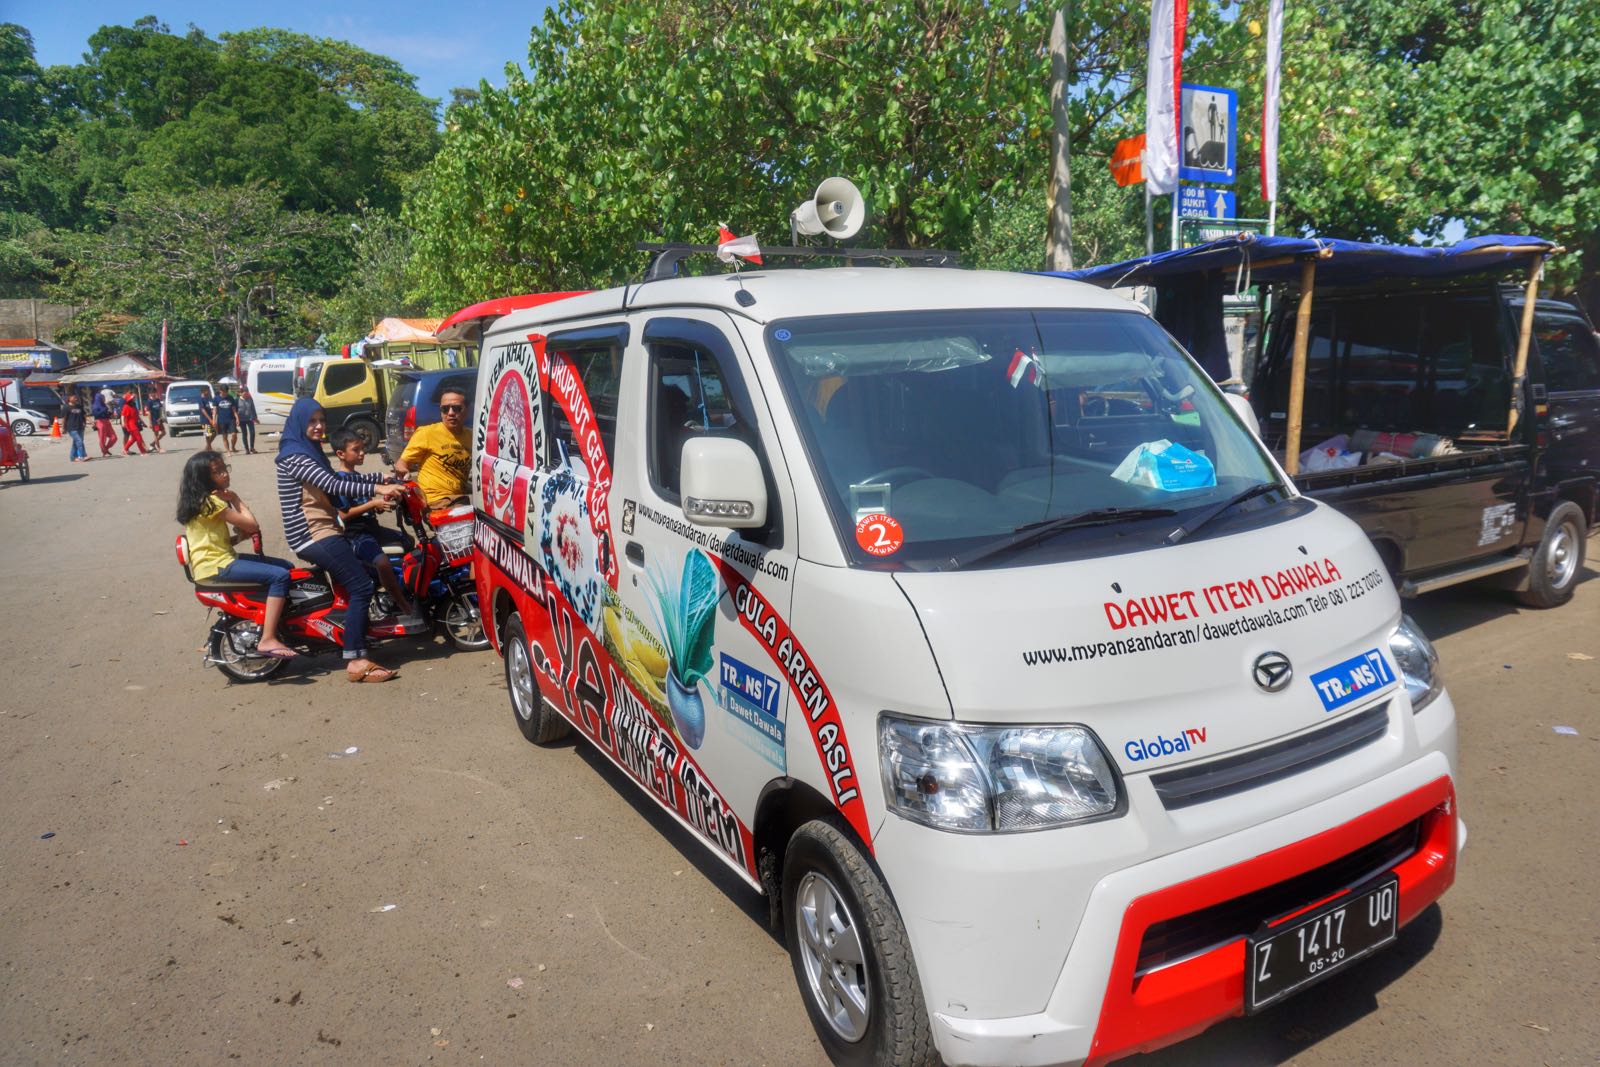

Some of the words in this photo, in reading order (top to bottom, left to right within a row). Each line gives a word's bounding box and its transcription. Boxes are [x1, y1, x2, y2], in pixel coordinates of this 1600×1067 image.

[1182, 198, 1207, 208] BUKIT
[1182, 208, 1209, 218] CAGAR
[506, 341, 527, 367] KHAS
[868, 523, 892, 547] 2
[880, 515, 897, 528] ITEM
[474, 516, 500, 561] DAWET
[500, 539, 545, 602] DAWALA
[1104, 590, 1200, 631] DAWET
[1202, 579, 1264, 614] ITEM
[1261, 558, 1343, 601] DAWALA
[1022, 603, 1308, 667] www.mypangandaran/dawetdawala.com
[1306, 594, 1329, 613] Telp
[1328, 587, 1349, 606] 081
[1347, 580, 1365, 600] 223
[735, 583, 778, 647] GULA
[777, 637, 829, 722] AREN
[817, 721, 858, 808] ASLI
[730, 696, 753, 722] Dawet
[753, 711, 782, 742] Dawala
[1258, 943, 1273, 982] Z
[1298, 909, 1346, 963] 1417
[1368, 888, 1393, 927] UQ
